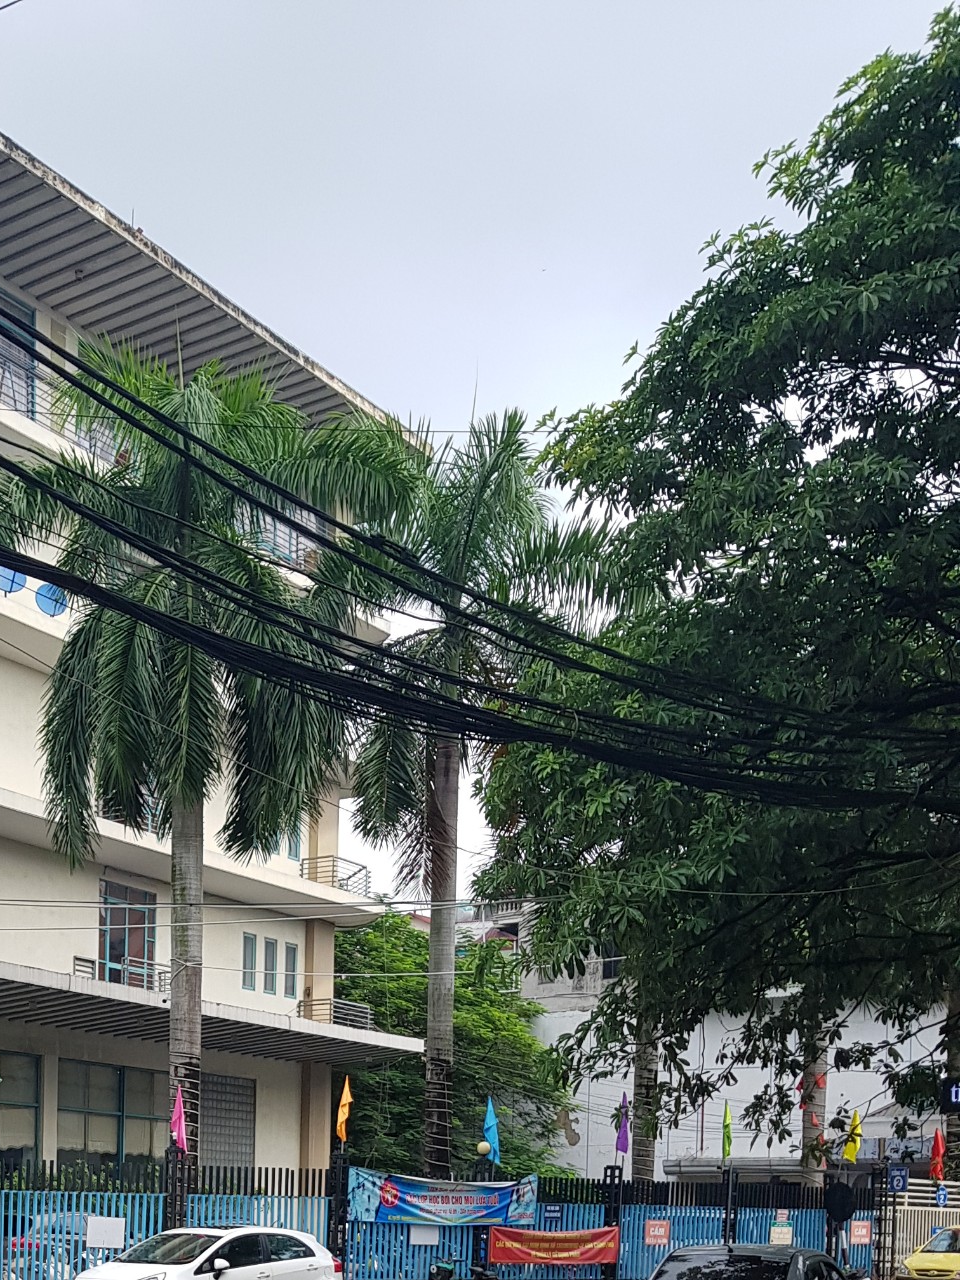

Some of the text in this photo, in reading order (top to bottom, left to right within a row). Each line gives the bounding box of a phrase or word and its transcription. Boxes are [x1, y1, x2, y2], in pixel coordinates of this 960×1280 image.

[895, 1178, 902, 1188] 2
[451, 1195, 463, 1205] CHO
[939, 1194, 945, 1204] 2
